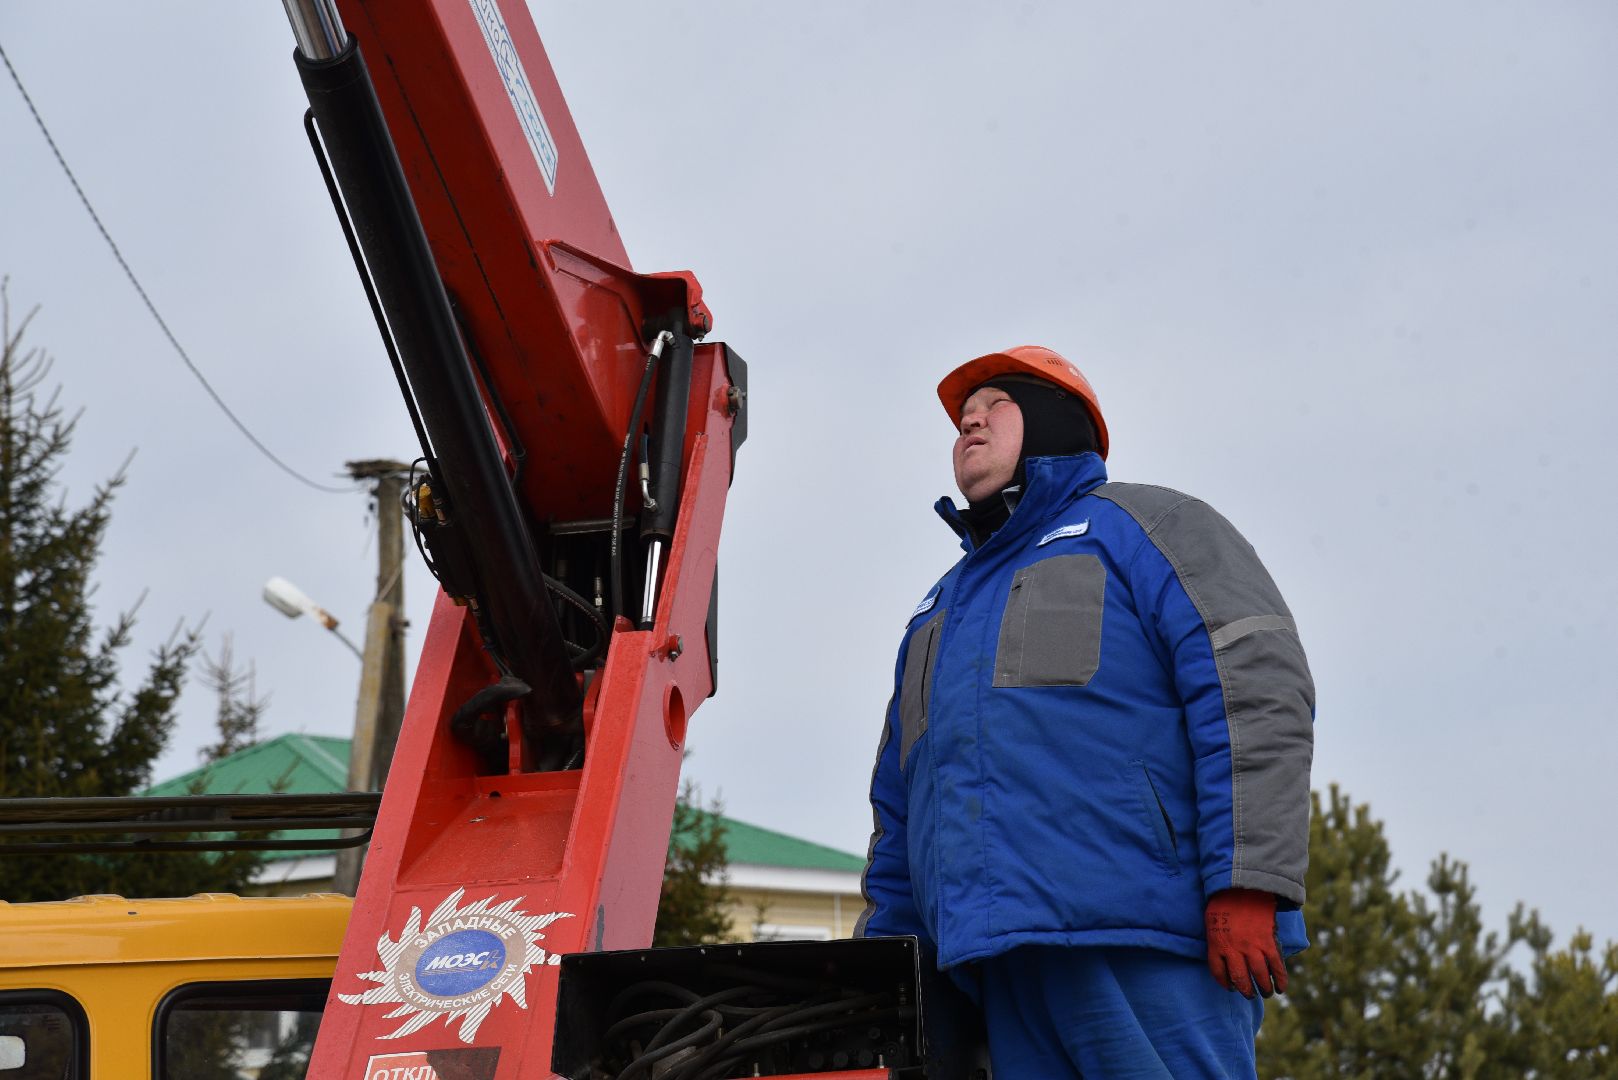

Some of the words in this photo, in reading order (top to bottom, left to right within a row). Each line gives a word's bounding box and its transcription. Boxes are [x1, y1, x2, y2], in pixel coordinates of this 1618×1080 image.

[414, 916, 517, 949] ЗАПАДНЫЕ
[398, 972, 491, 1009] ЭЛЕКТРИЧЕСКИЕ
[490, 963, 518, 991] СЕТИ
[373, 1066, 437, 1080] ОТКЛ
